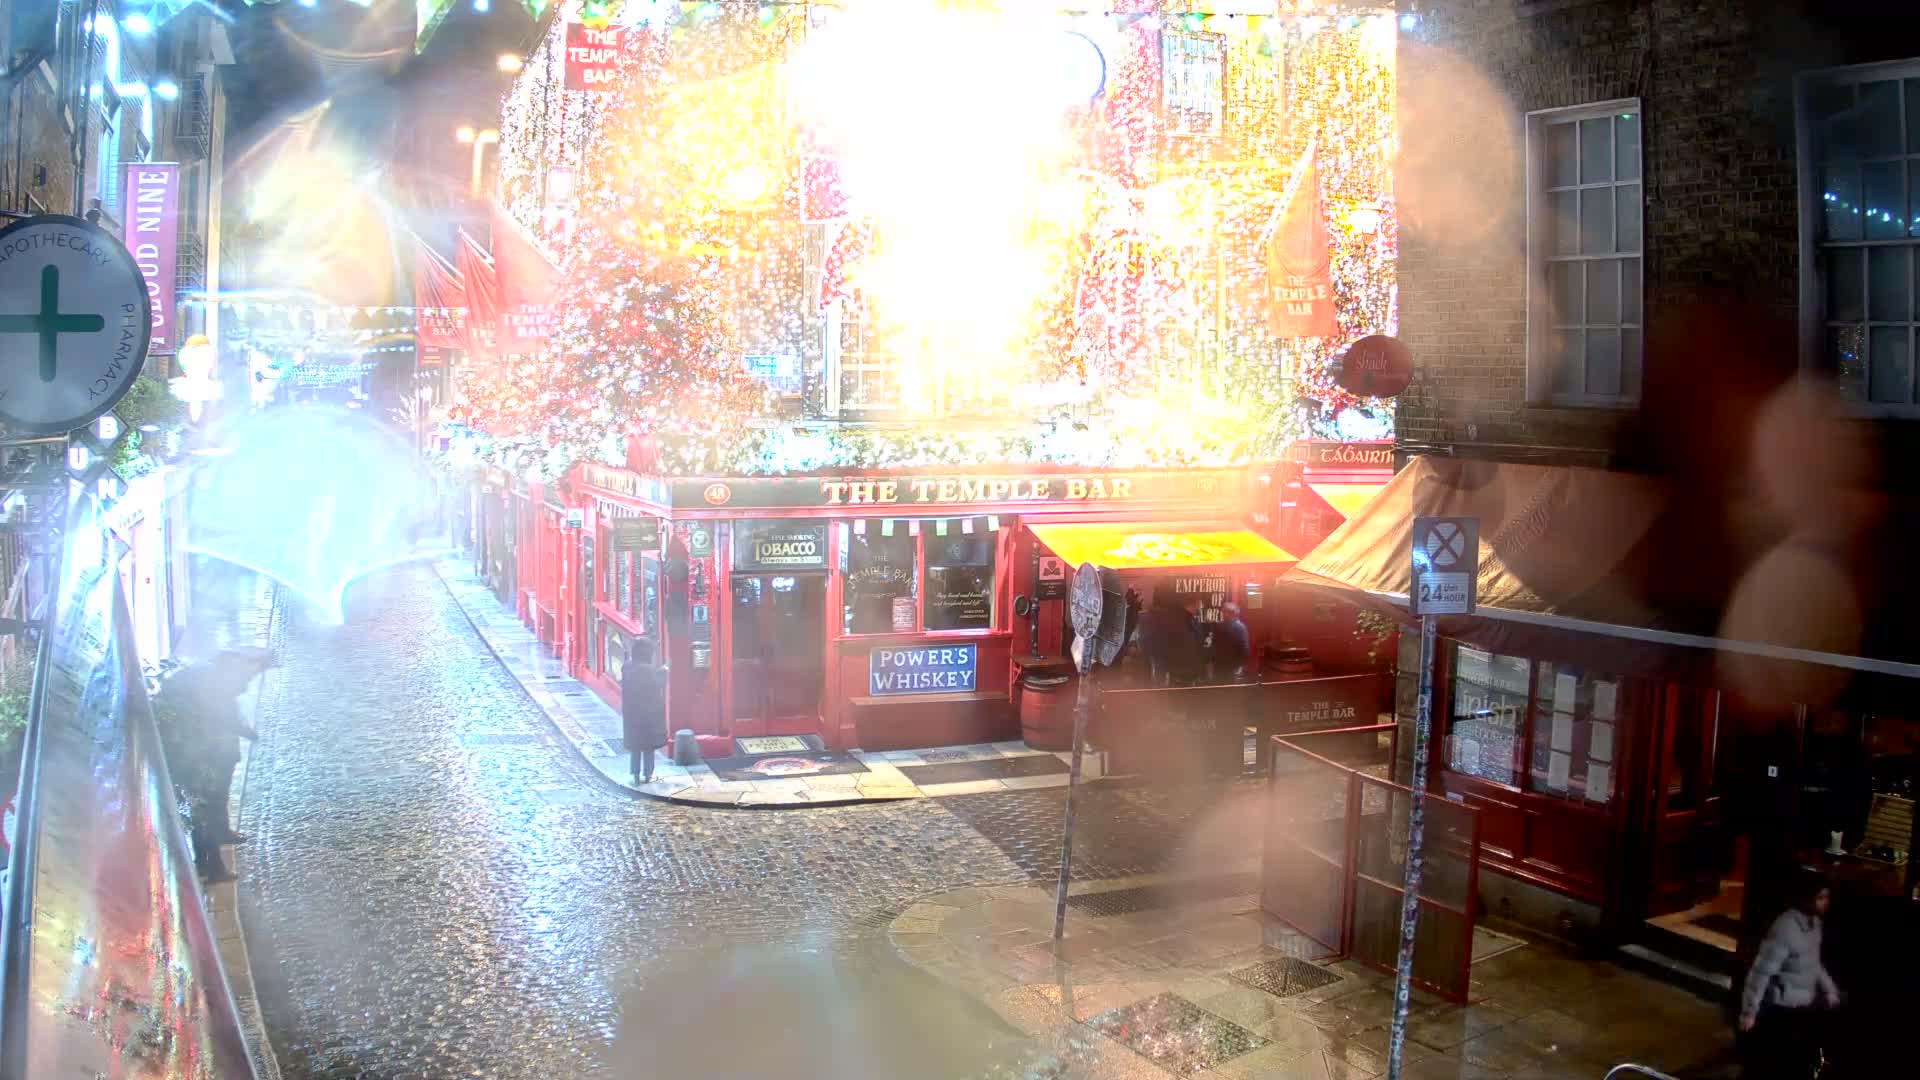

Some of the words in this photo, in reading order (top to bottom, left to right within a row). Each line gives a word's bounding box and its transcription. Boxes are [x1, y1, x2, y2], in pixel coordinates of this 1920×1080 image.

[584, 30, 617, 45] THE
[568, 47, 624, 63] TEMPL
[136, 171, 169, 232] NINE
[1272, 284, 1327, 302] TEMPLE
[1287, 302, 1313, 315] BAR
[88, 303, 136, 400] PHARMACY
[823, 481, 898, 504] THE
[911, 477, 1050, 503] TEMPLE
[1064, 477, 1131, 501] BAR
[753, 538, 816, 561] TOBACCO
[1176, 578, 1225, 593] EMPEROR
[1421, 584, 1443, 602] 24
[1211, 592, 1225, 607] OF
[879, 647, 969, 668] POWER'S
[873, 670, 973, 690] WHISKEY
[1287, 709, 1329, 722] TEMPLE
[1332, 707, 1355, 719] BAR
